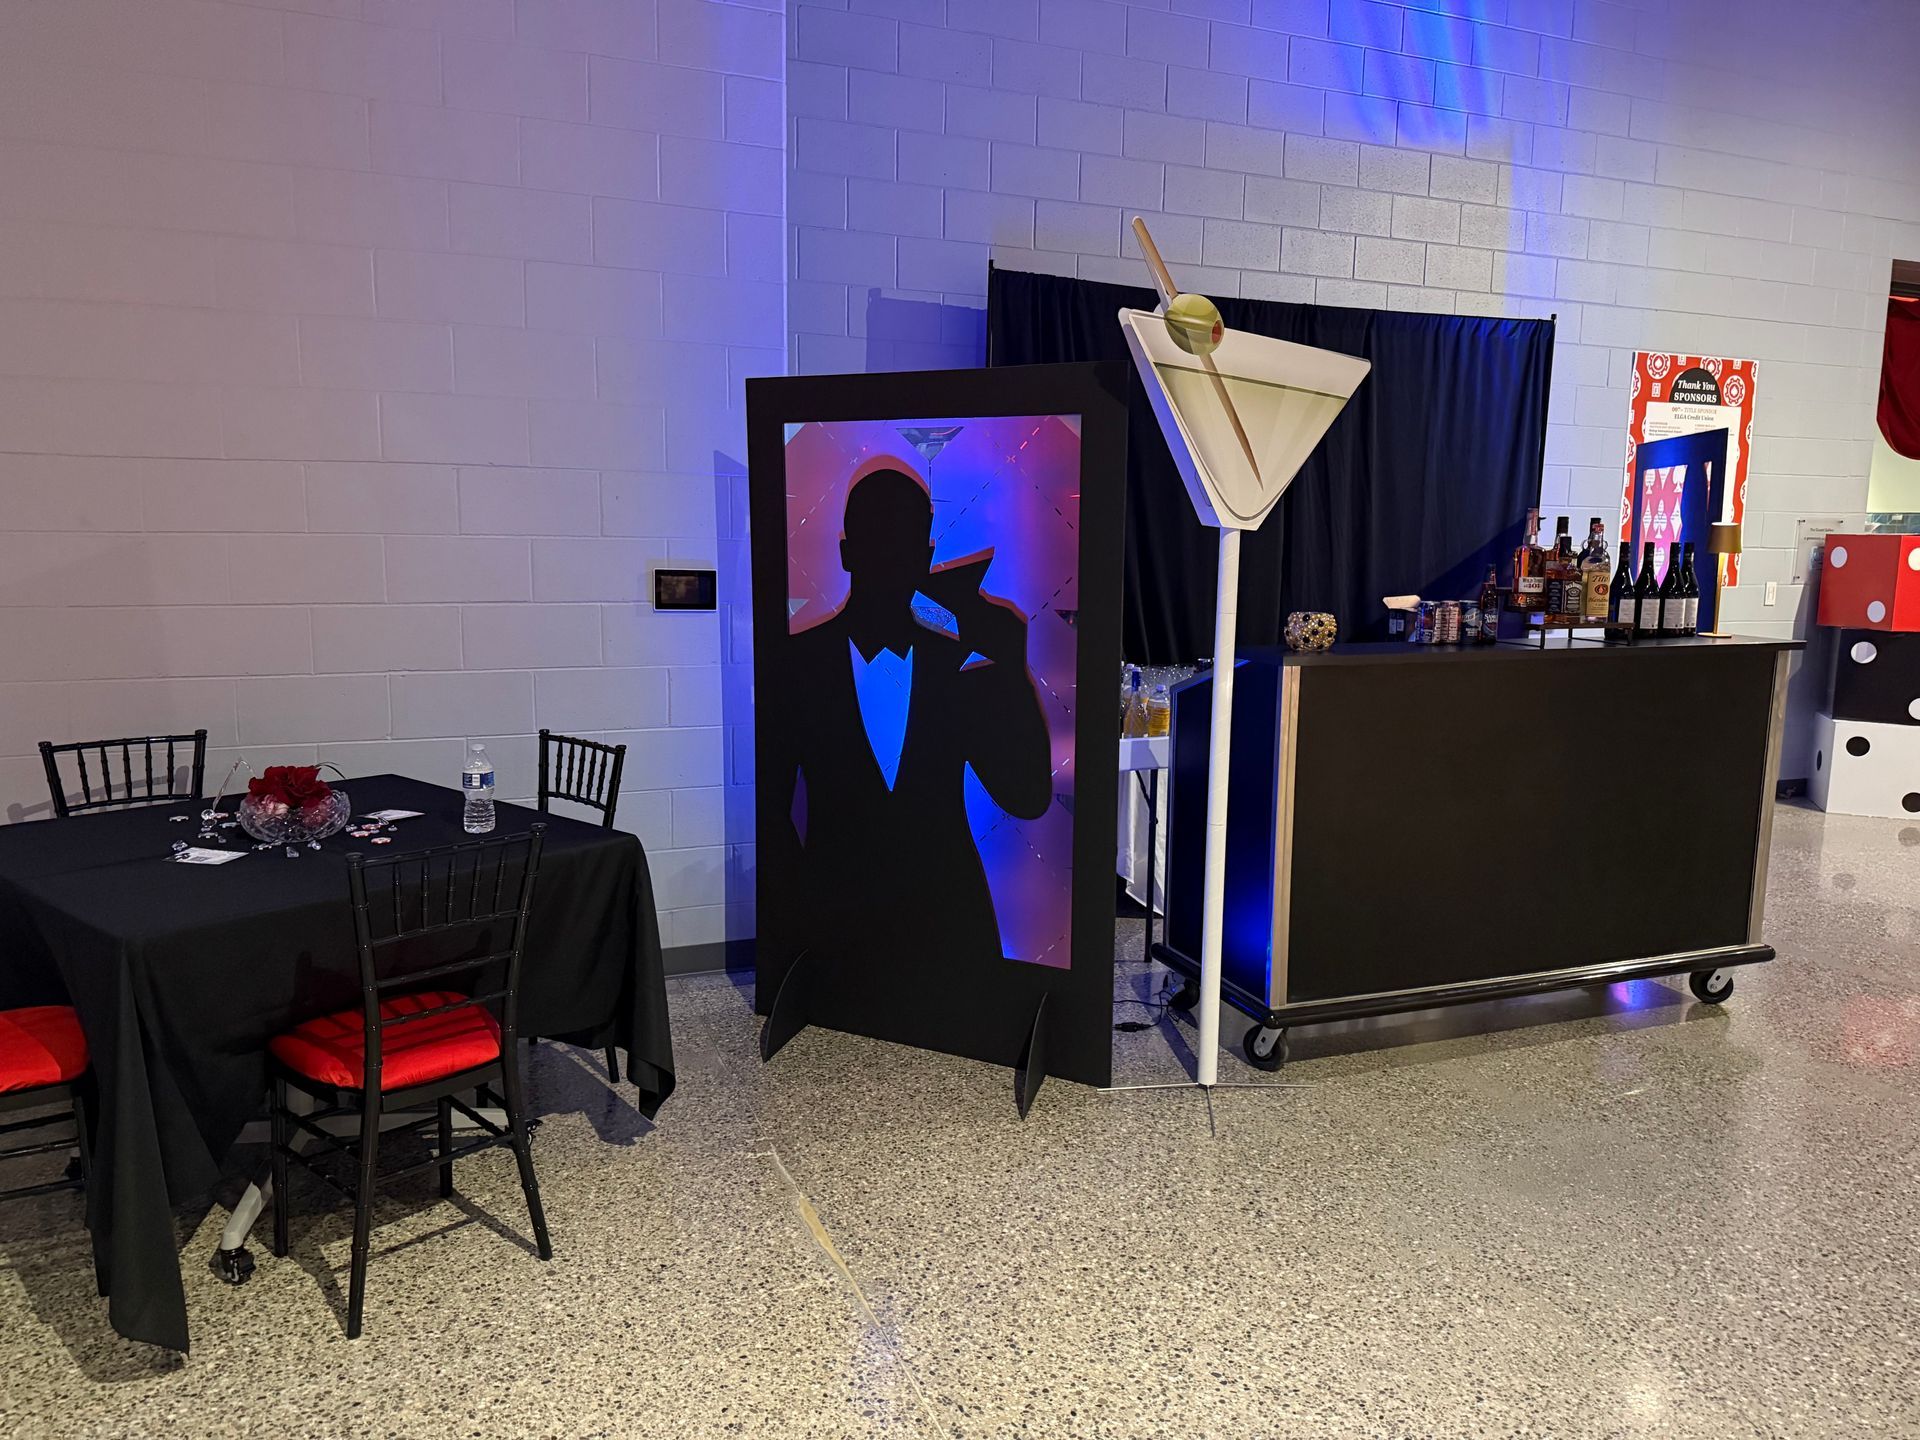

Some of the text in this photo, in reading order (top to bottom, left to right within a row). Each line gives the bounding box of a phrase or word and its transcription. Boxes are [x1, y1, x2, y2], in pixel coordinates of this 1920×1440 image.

[1677, 380, 1716, 391] Thank You
[1673, 392, 1717, 403] SPONSORS
